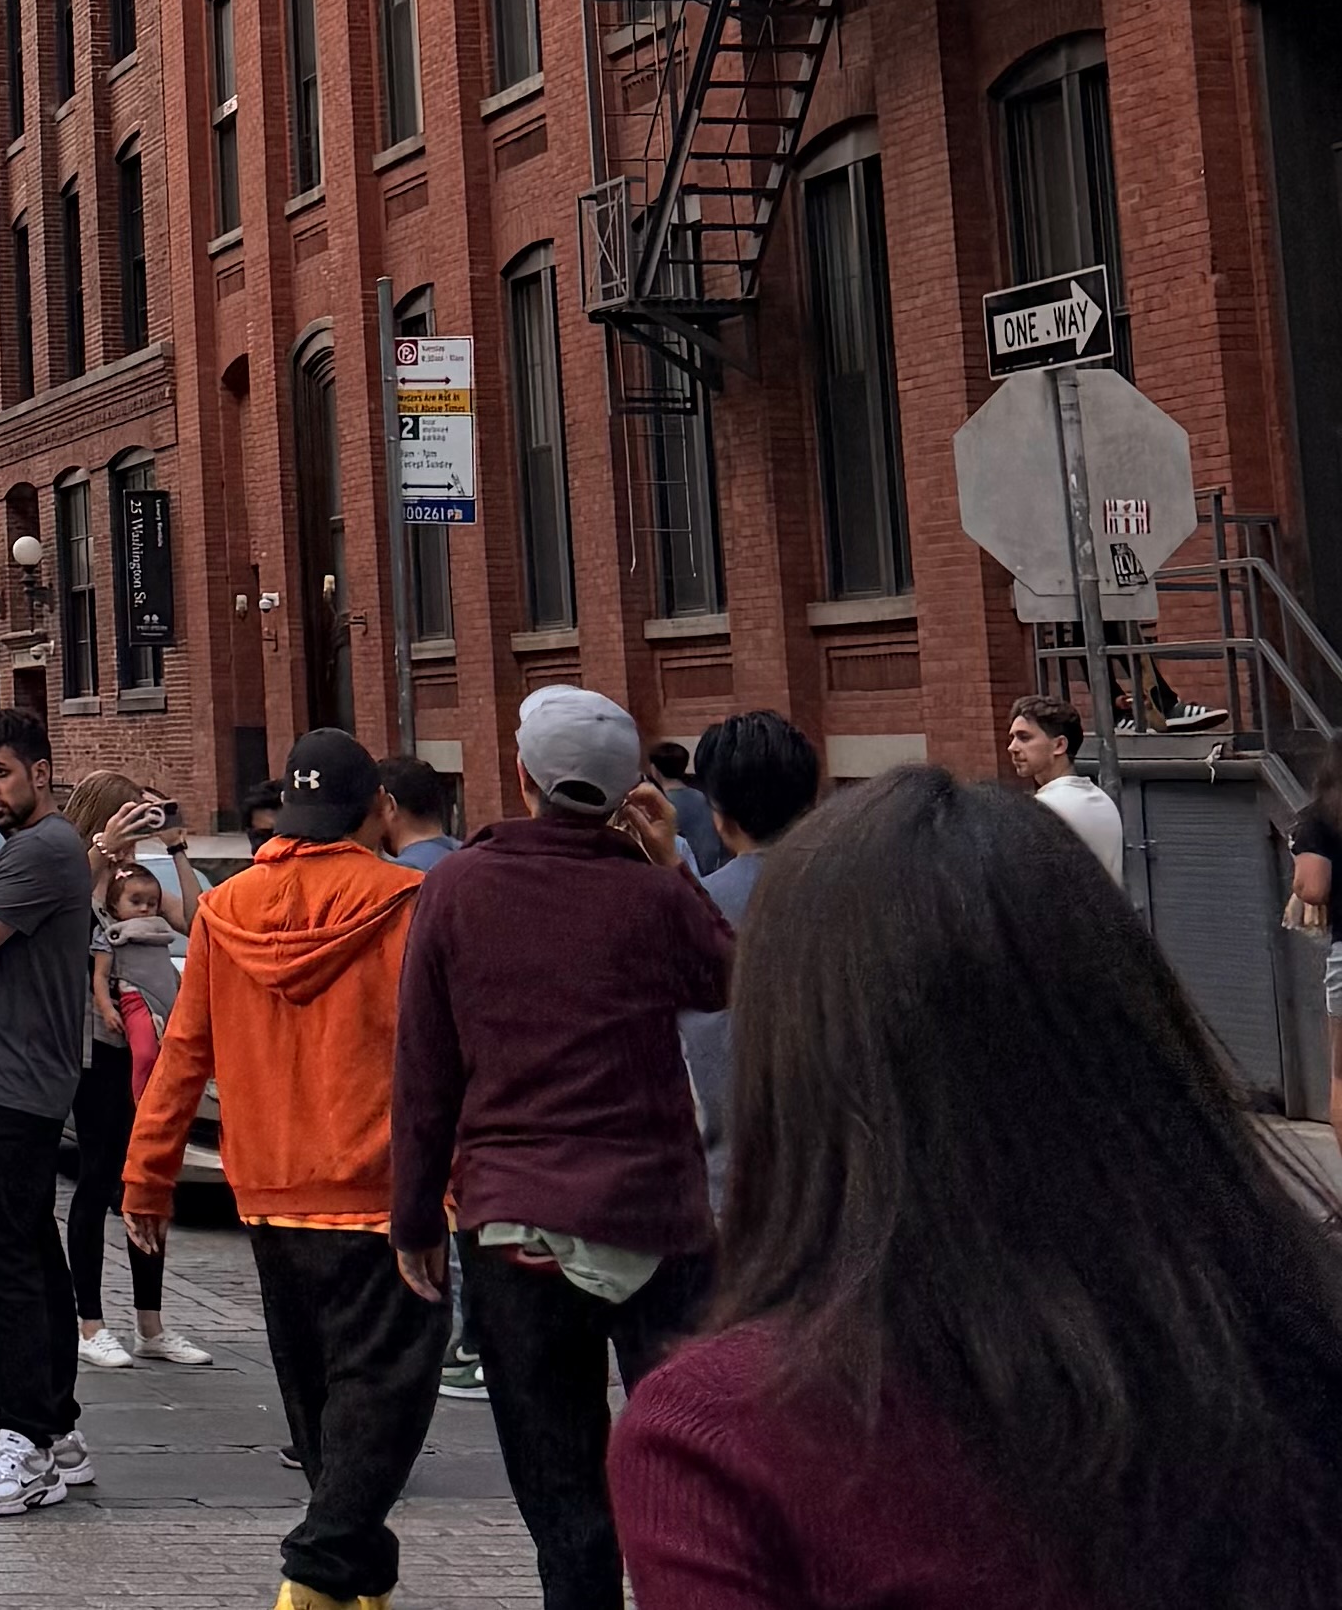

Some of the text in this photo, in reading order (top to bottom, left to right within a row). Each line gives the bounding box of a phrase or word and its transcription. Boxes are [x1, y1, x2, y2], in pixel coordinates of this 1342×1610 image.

[1004, 300, 1088, 348] ONE WAY
[401, 417, 414, 439] 2
[130, 499, 142, 514] 25
[129, 517, 144, 589] Washington
